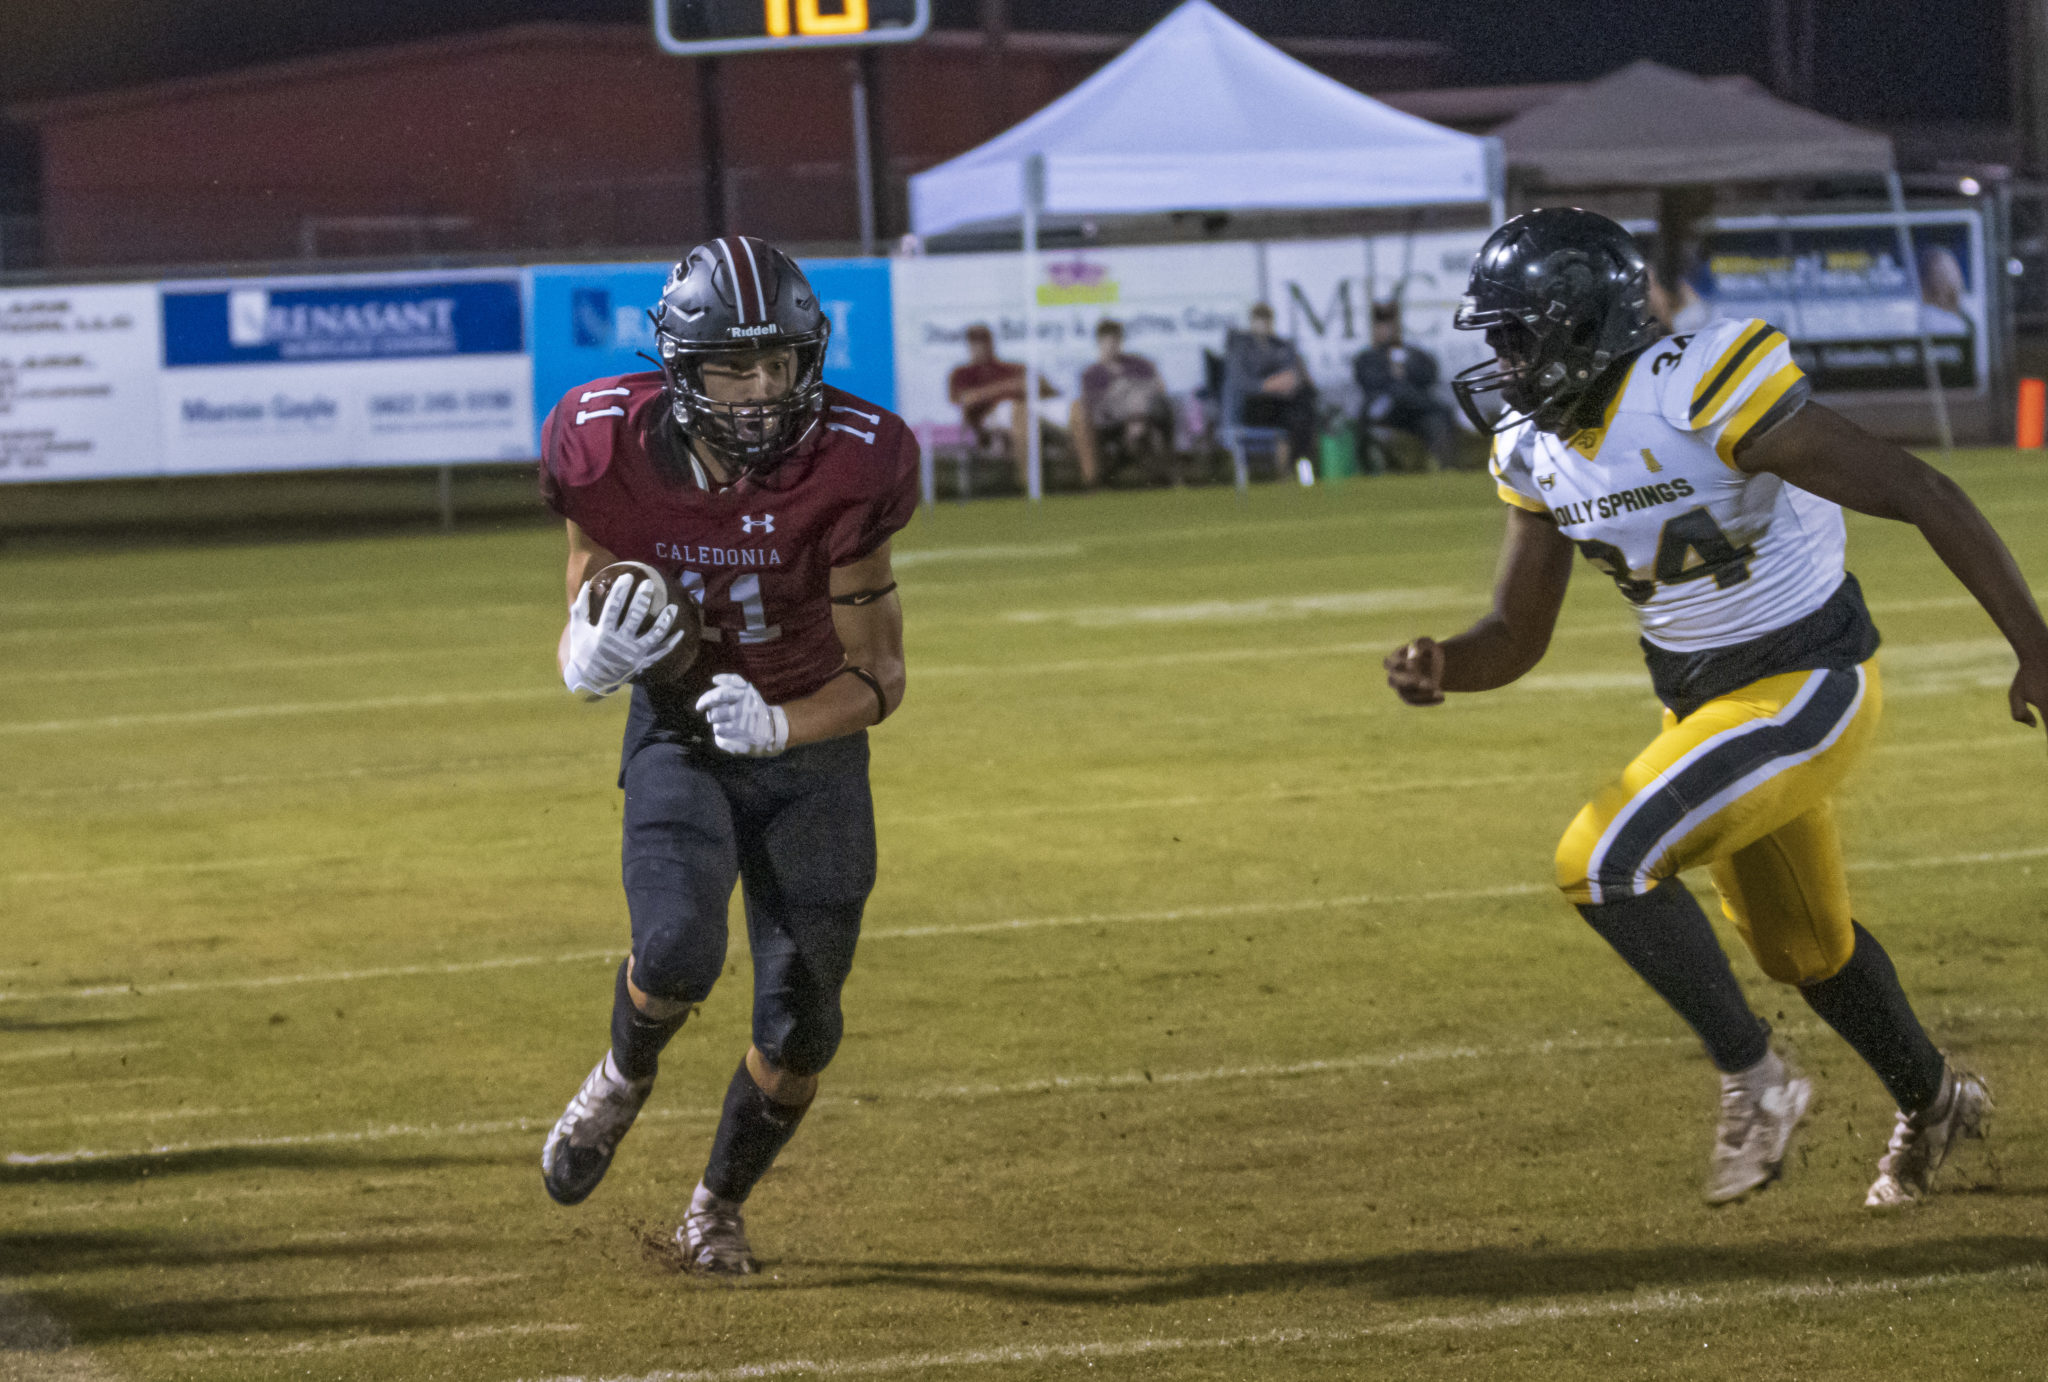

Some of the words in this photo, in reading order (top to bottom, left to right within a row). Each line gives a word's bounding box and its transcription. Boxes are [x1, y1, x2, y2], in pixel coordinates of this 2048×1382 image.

[731, 323, 777, 338] Riddell
[576, 387, 631, 425] 11
[1553, 499, 1594, 527] OLLY
[1597, 478, 1695, 519] SPRINGS
[656, 542, 782, 566] CALEDONIA
